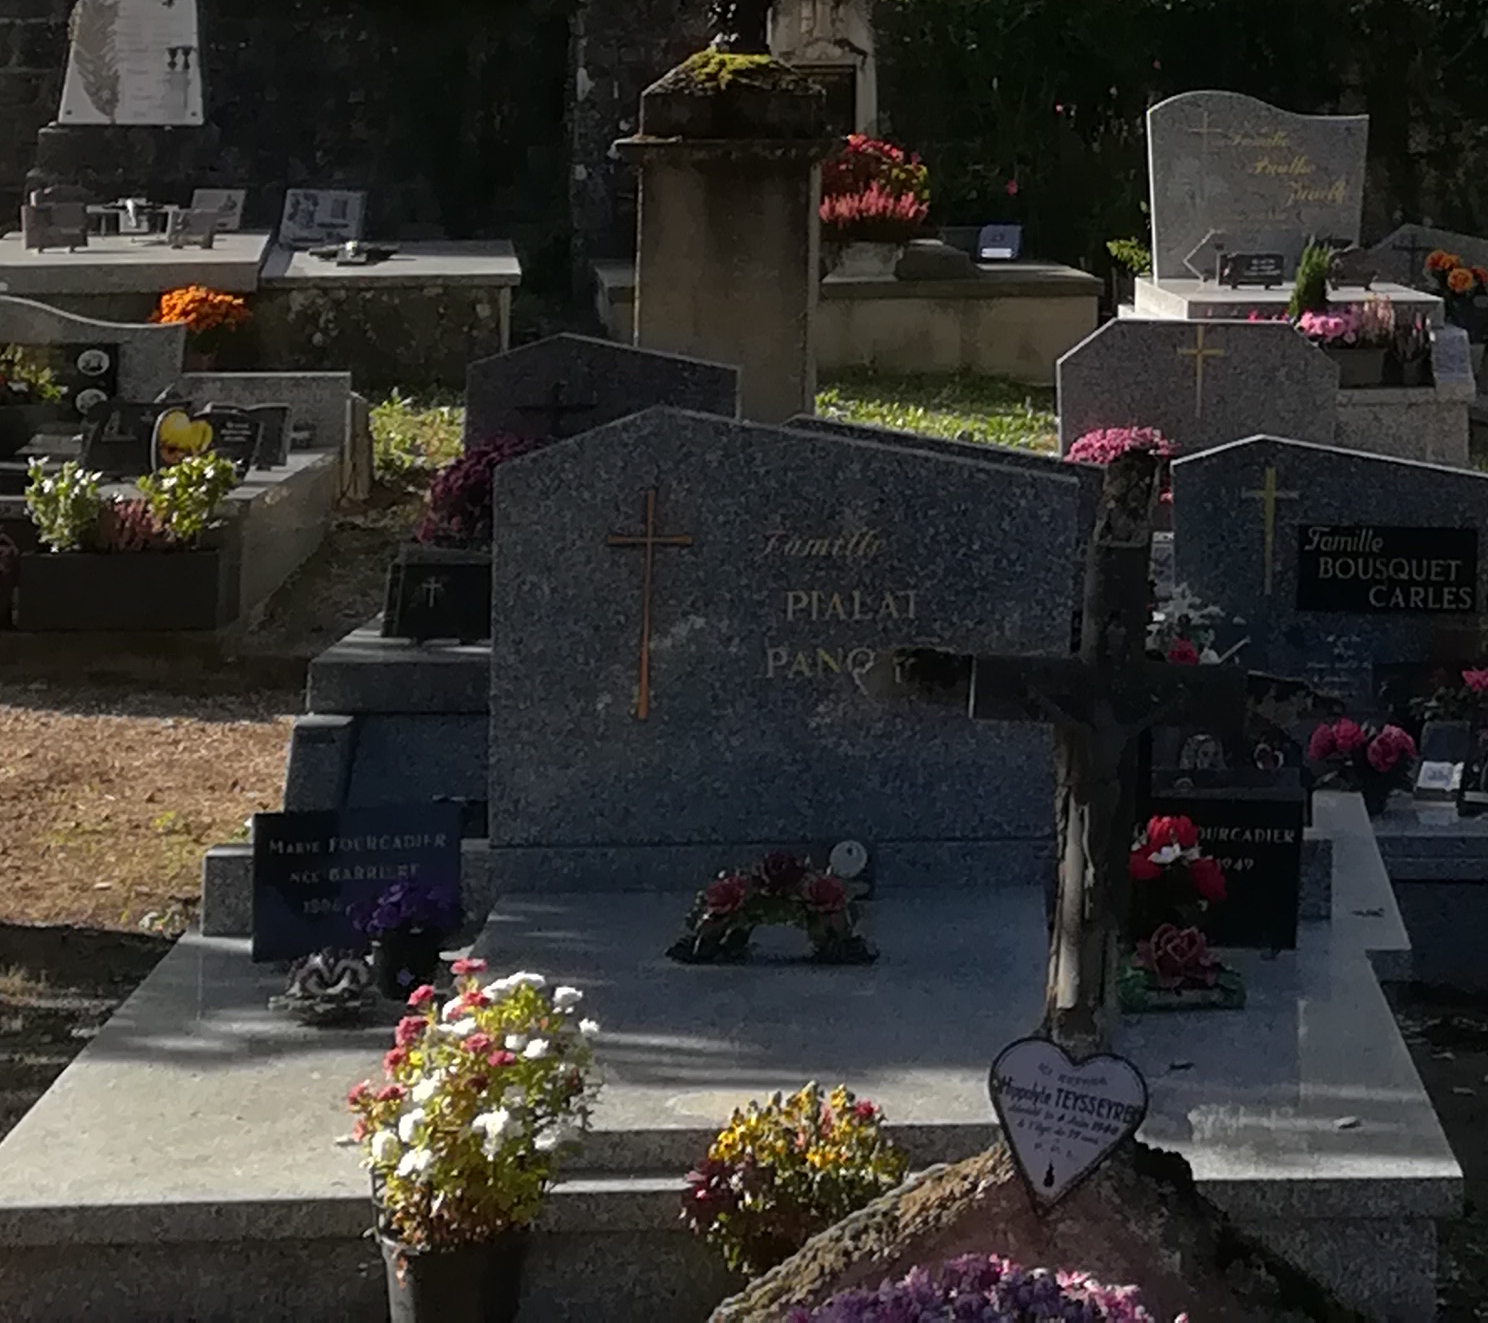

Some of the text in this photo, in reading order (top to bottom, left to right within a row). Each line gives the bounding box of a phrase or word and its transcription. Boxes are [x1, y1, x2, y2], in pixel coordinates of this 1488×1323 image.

[1303, 526, 1384, 553] Famille
[1317, 556, 1463, 582] BOUSQUET
[785, 589, 917, 622] PIALAT
[1368, 585, 1473, 610] CARLES
[1198, 826, 1295, 844] OURCADIER
[1055, 1088, 1135, 1124] TEYSSEYRE
